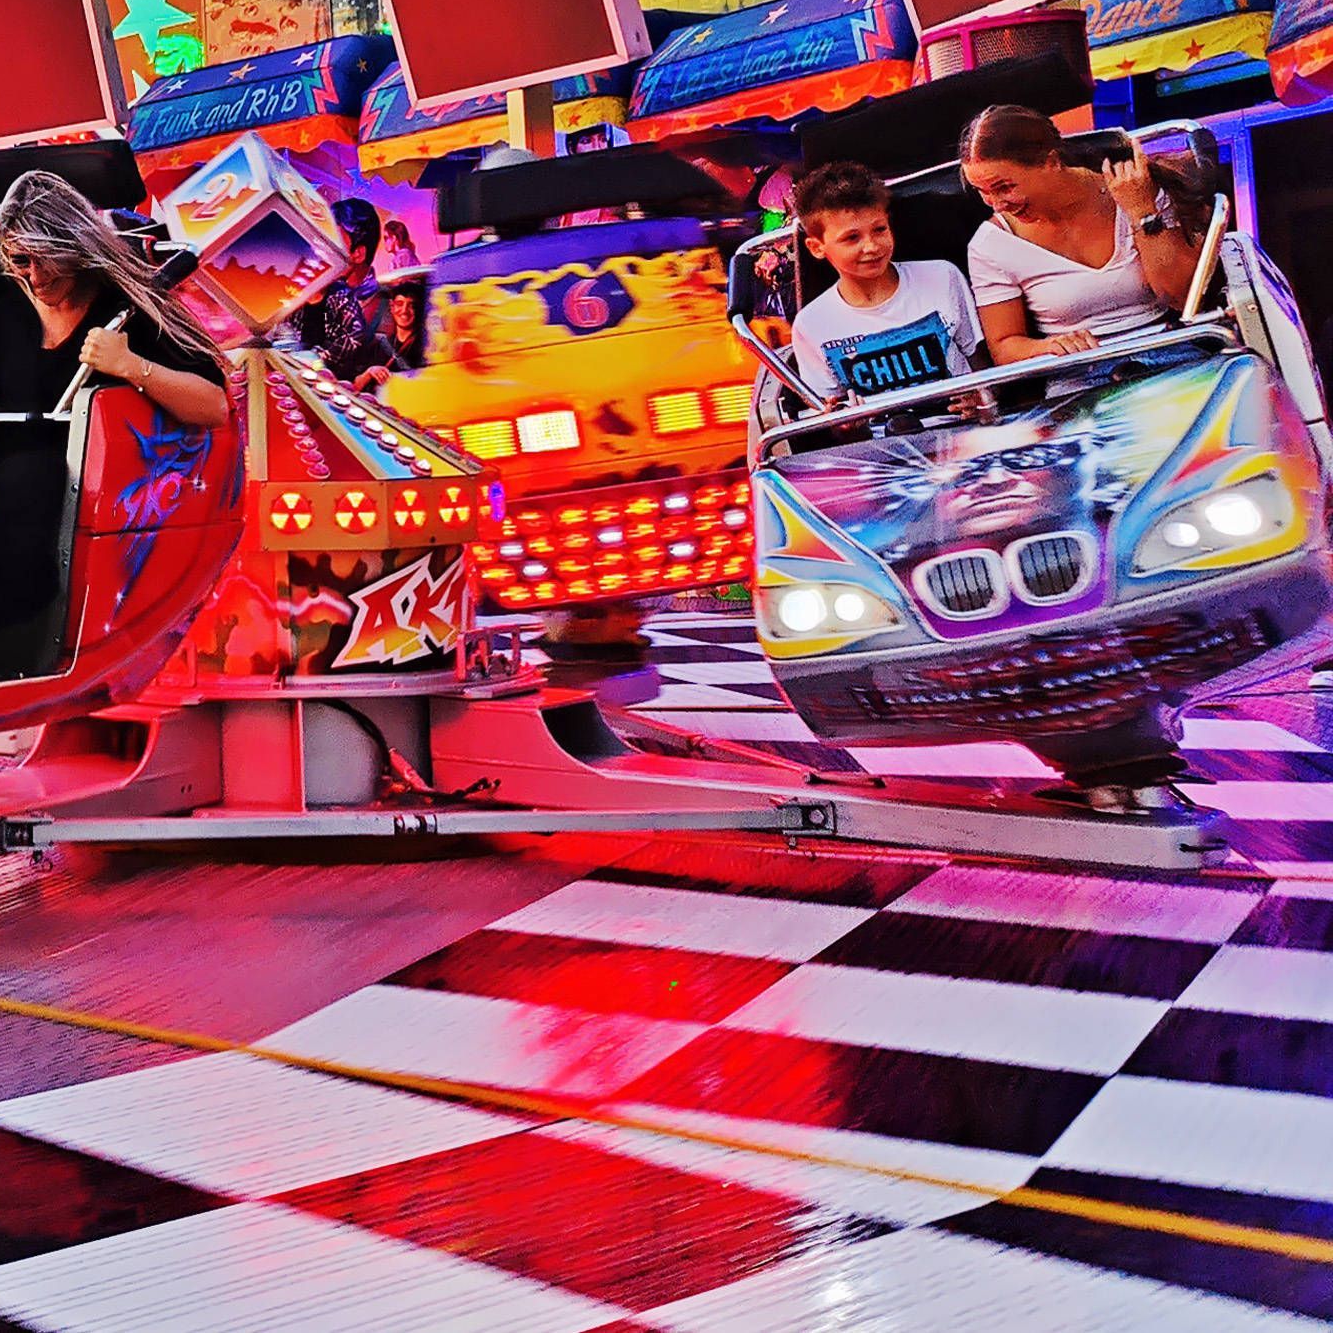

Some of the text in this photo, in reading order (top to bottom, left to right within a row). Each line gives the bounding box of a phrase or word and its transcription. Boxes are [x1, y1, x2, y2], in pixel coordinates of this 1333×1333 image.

[790, 30, 839, 71] fun
[152, 105, 201, 139] Funk
[202, 90, 248, 127] and
[188, 172, 238, 222] 2
[562, 278, 610, 328] 6
[852, 345, 939, 390] CHILL
